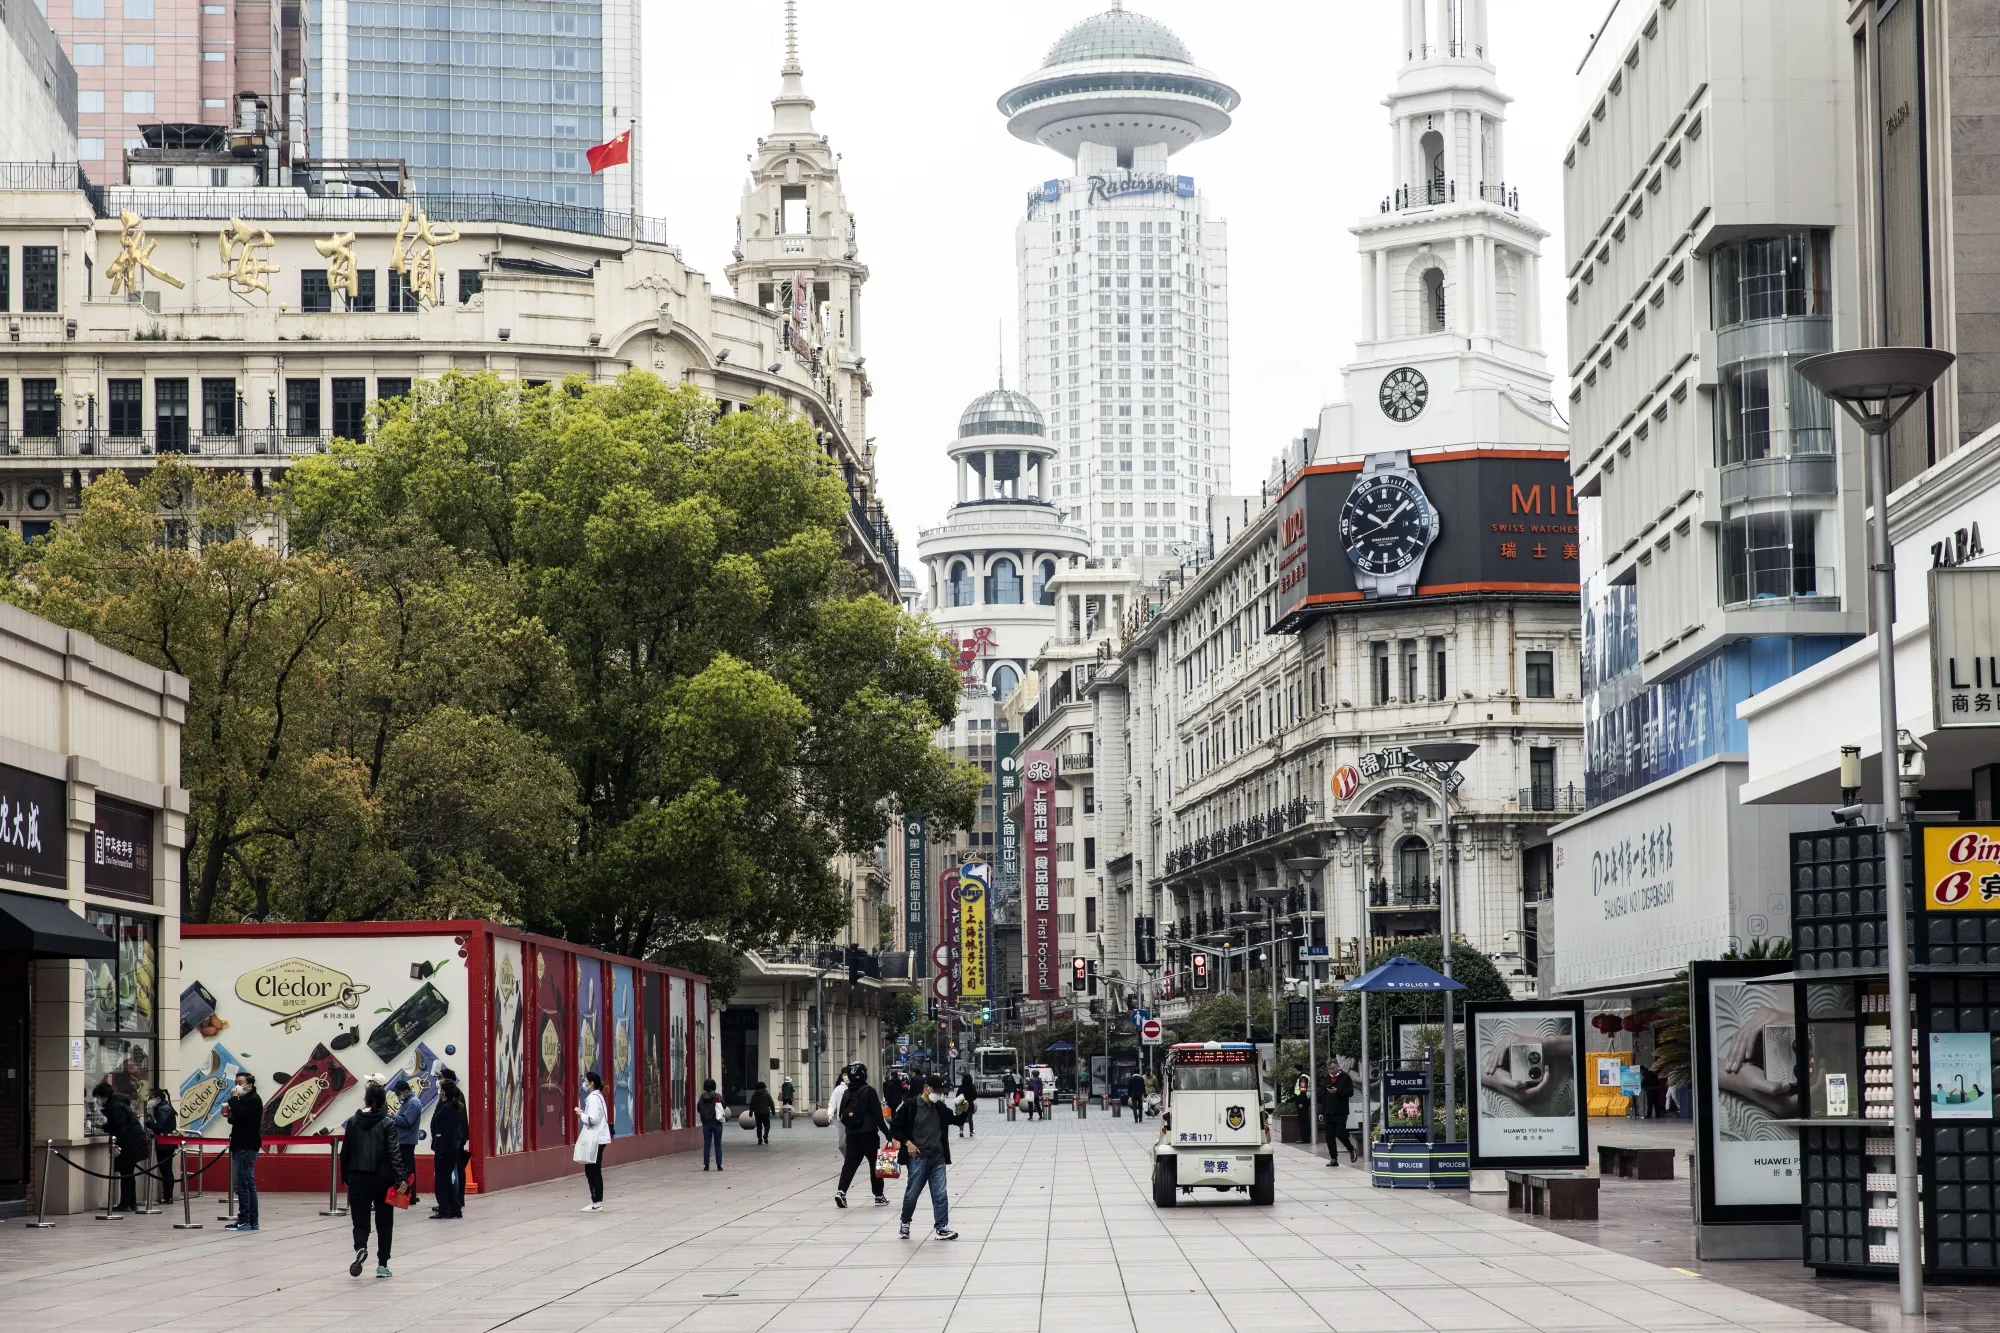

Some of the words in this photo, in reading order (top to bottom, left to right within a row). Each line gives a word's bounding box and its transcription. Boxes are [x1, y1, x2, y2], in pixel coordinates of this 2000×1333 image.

[1087, 169, 1175, 206] Radisson
[1178, 182, 1194, 191] BLU
[1357, 481, 1372, 494] 55
[1421, 513, 1429, 526] 15
[1491, 523, 1525, 532] SWISS
[1530, 524, 1579, 534] WATCHES
[1930, 520, 1984, 568] ZARA
[105, 836, 133, 858] 中华老字号
[1033, 787, 1049, 911] 上海市第一食品商店
[1949, 834, 2000, 866] Bin
[909, 838, 921, 922] 第一百货商业中心
[1037, 918, 1048, 940] First
[1076, 968, 1085, 979] 10
[1197, 966, 1205, 976] 10
[255, 975, 332, 997] Clédor
[1315, 1006, 1320, 1015] I
[1315, 1015, 1331, 1024] SH
[180, 1085, 212, 1119] Clédor
[281, 1085, 314, 1119] Clédor
[1179, 1132, 1213, 1142] 黄浦117
[1203, 1160, 1229, 1173] 警察
[1754, 1157, 1791, 1165] HUAWEI
